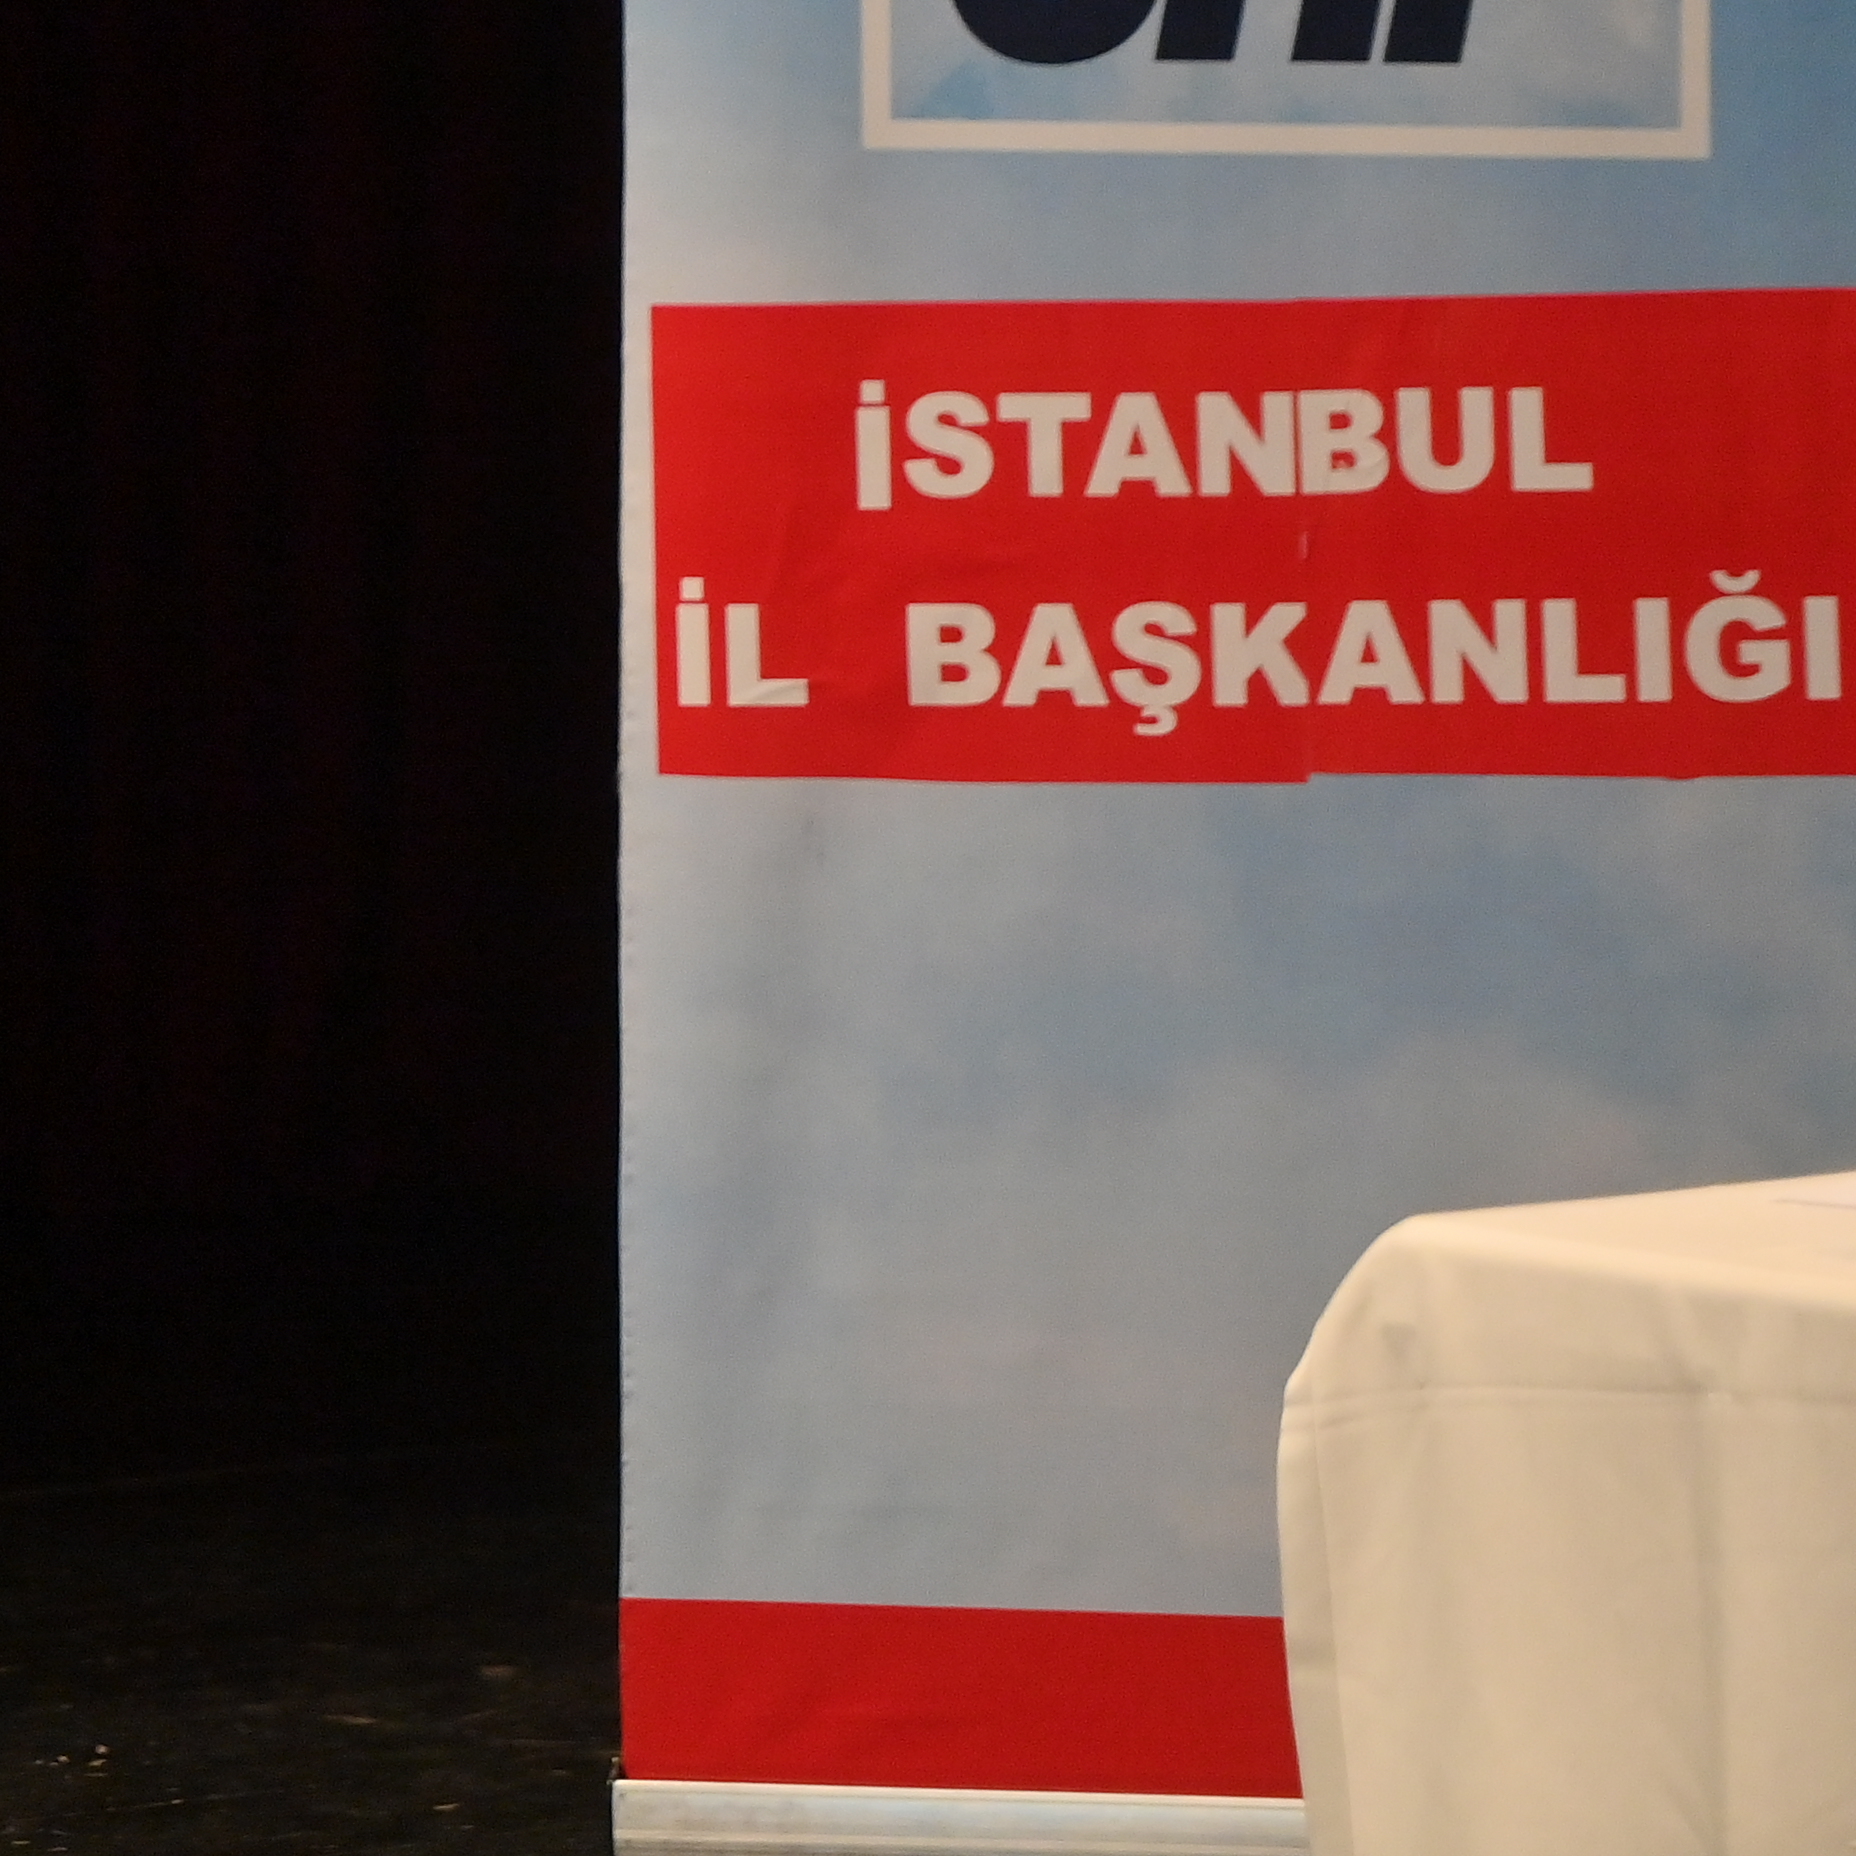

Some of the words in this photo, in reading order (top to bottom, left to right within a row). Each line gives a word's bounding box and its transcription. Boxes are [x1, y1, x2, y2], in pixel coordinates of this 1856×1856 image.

[855, 378, 1594, 511] İSTANBUL
[674, 576, 810, 707] İL
[904, 569, 1842, 735] BAŞKANLIĞI
